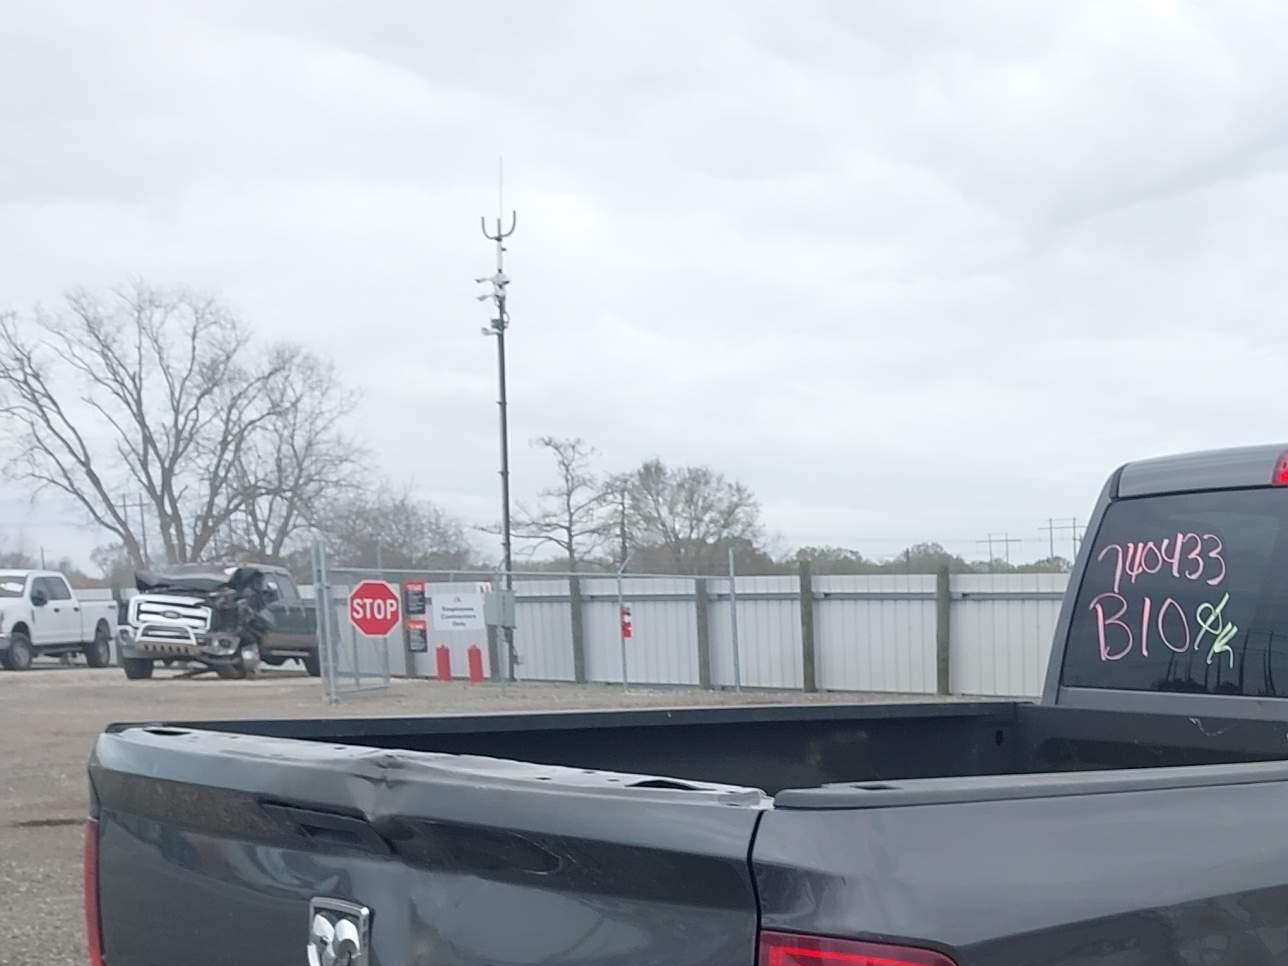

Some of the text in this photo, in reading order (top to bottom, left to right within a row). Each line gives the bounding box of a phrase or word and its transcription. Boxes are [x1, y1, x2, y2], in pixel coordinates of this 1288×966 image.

[1098, 533, 1226, 593] 740433
[353, 599, 397, 619] STOP
[1089, 593, 1190, 661] B10
